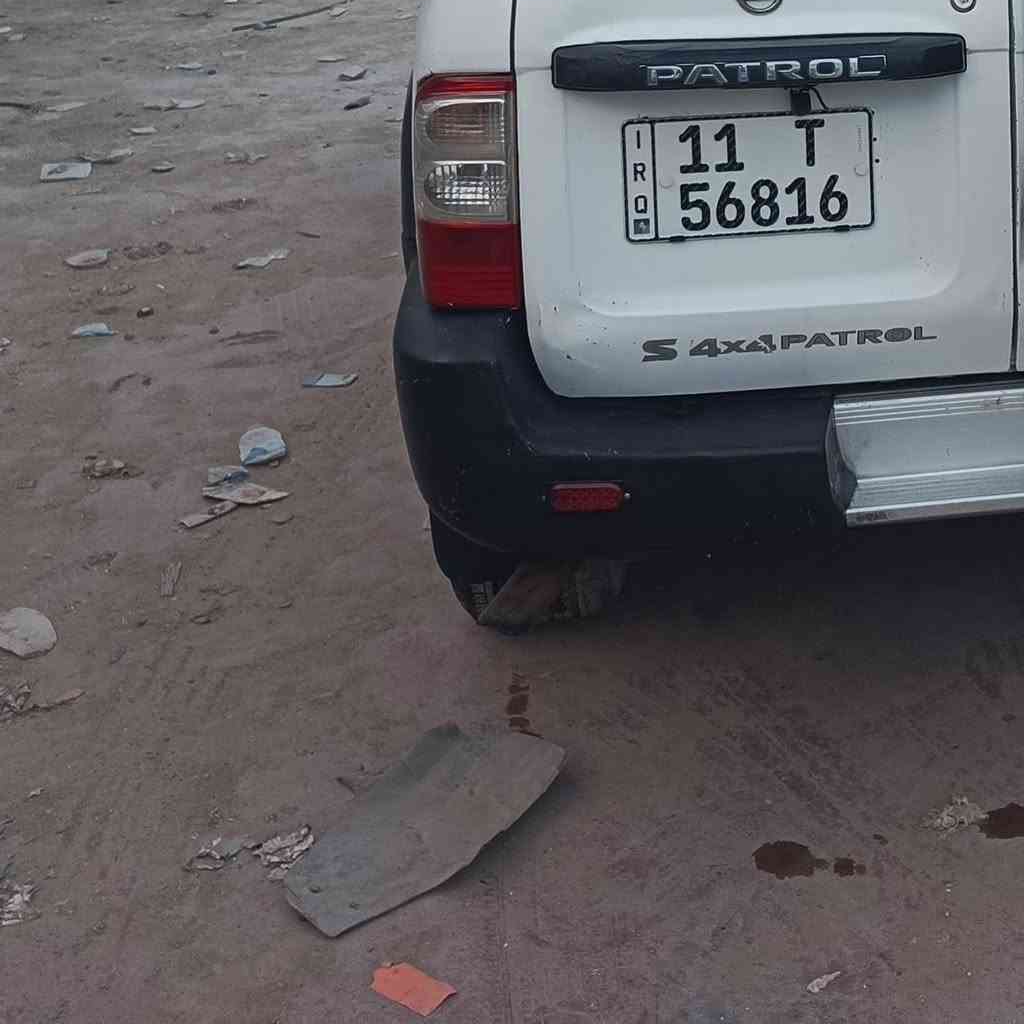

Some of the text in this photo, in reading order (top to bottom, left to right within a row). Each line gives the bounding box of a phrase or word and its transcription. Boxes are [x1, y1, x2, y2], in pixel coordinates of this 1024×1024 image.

[645, 55, 888, 86] PATROL
[679, 118, 825, 174] 11 T
[680, 174, 849, 232] 56816
[641, 338, 678, 363] S
